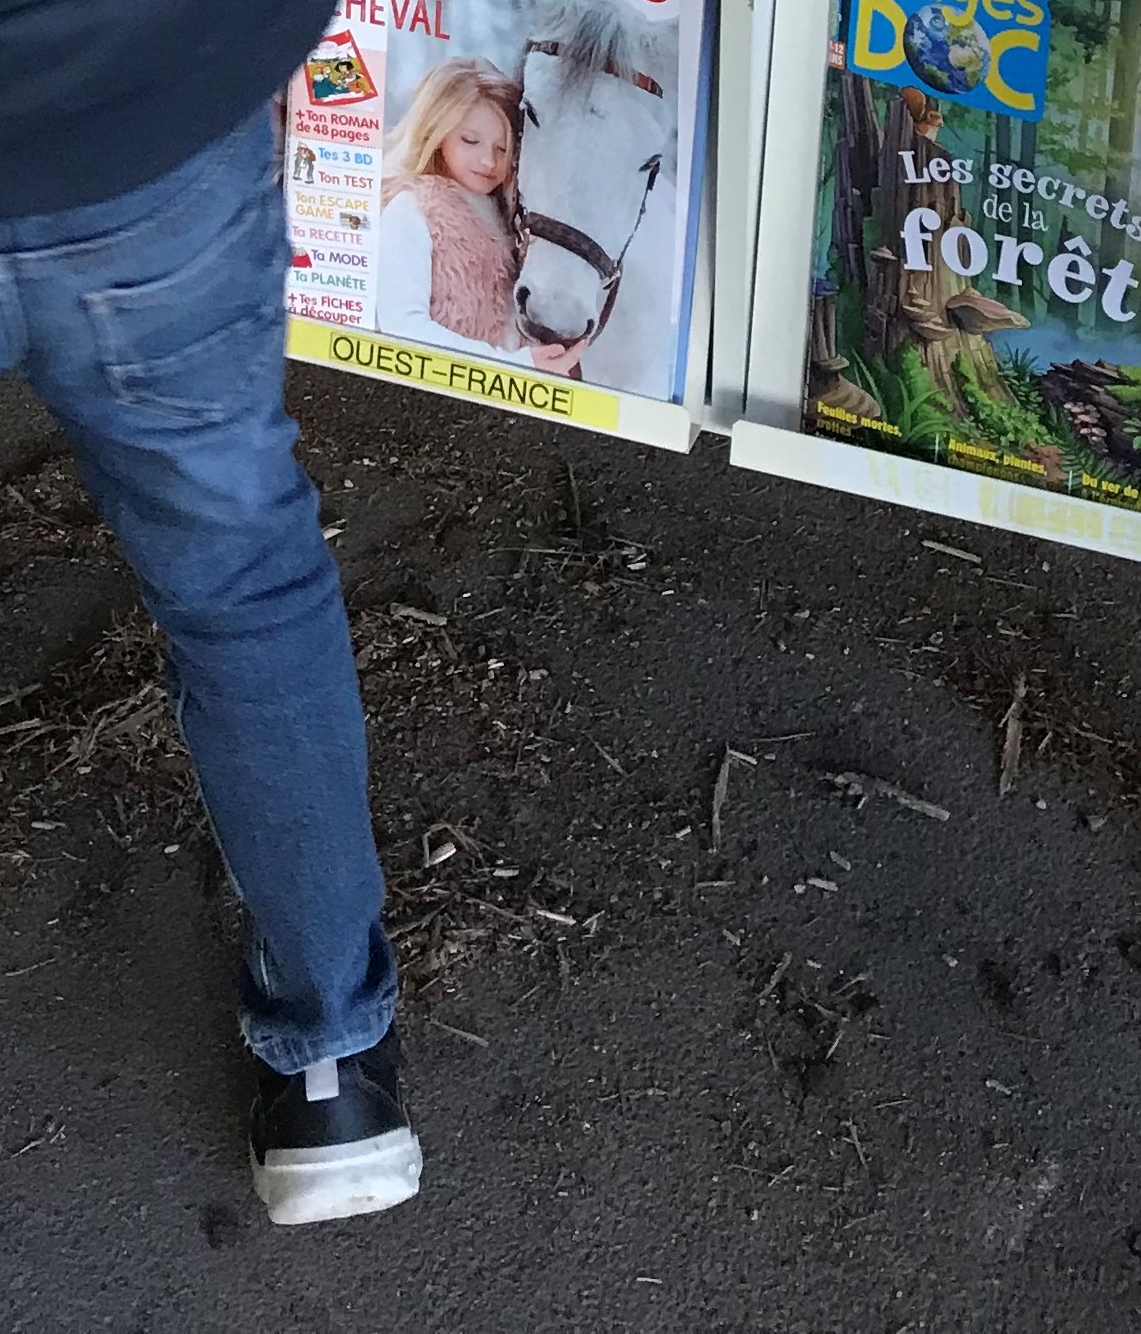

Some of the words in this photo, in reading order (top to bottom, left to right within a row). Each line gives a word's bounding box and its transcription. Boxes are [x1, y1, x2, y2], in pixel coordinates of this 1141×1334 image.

[296, 121, 311, 133] de
[313, 124, 329, 136] 48
[331, 128, 370, 142] pages
[331, 113, 380, 131] ROMAN
[318, 147, 339, 161] Tes
[343, 151, 351, 163] 3
[354, 153, 373, 165] BD
[318, 171, 340, 185] Ton
[344, 174, 374, 189] TEST
[295, 191, 316, 205] Ton
[319, 194, 370, 212] ESCAPE
[898, 150, 974, 184] Les
[989, 163, 1141, 241] secrets
[295, 204, 334, 220] GAME
[983, 194, 1013, 222] de
[1023, 202, 1049, 232] la
[292, 225, 306, 238] Ta
[309, 228, 364, 246] RECETTE
[311, 249, 325, 261] Ta
[329, 252, 369, 268] MODE
[900, 207, 1139, 322] forêt
[294, 270, 308, 283] Ta
[299, 293, 318, 306] Tes
[321, 295, 364, 313] FICHES
[301, 305, 362, 325] découper
[333, 336, 570, 415] OUEST-FRANCE
[817, 401, 858, 425] Feuilles
[861, 416, 903, 438] mortes,
[948, 438, 999, 464] Animaux,
[1003, 452, 1048, 476] plantes,
[1082, 472, 1098, 488] Du
[1101, 477, 1121, 494] ver
[1123, 483, 1140, 499] de
